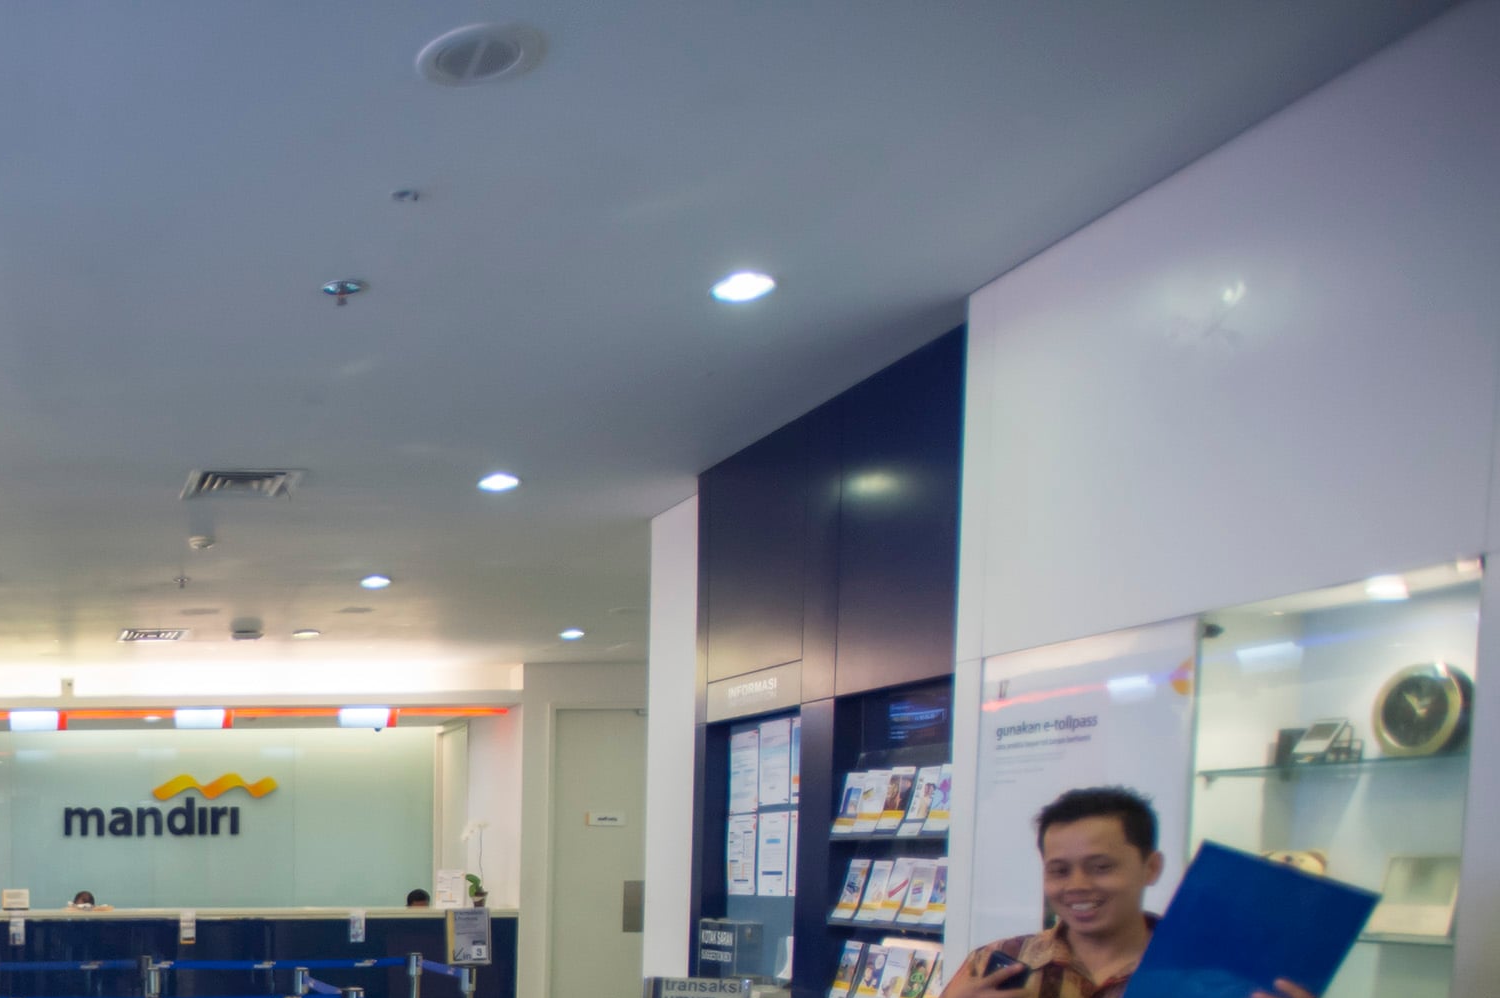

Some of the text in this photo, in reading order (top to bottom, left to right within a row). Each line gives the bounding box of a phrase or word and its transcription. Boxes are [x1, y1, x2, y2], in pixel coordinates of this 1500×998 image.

[727, 677, 778, 698] INFORMASI
[996, 721, 1041, 741] gunakan
[63, 797, 240, 837] mandiri
[475, 947, 483, 957] 3
